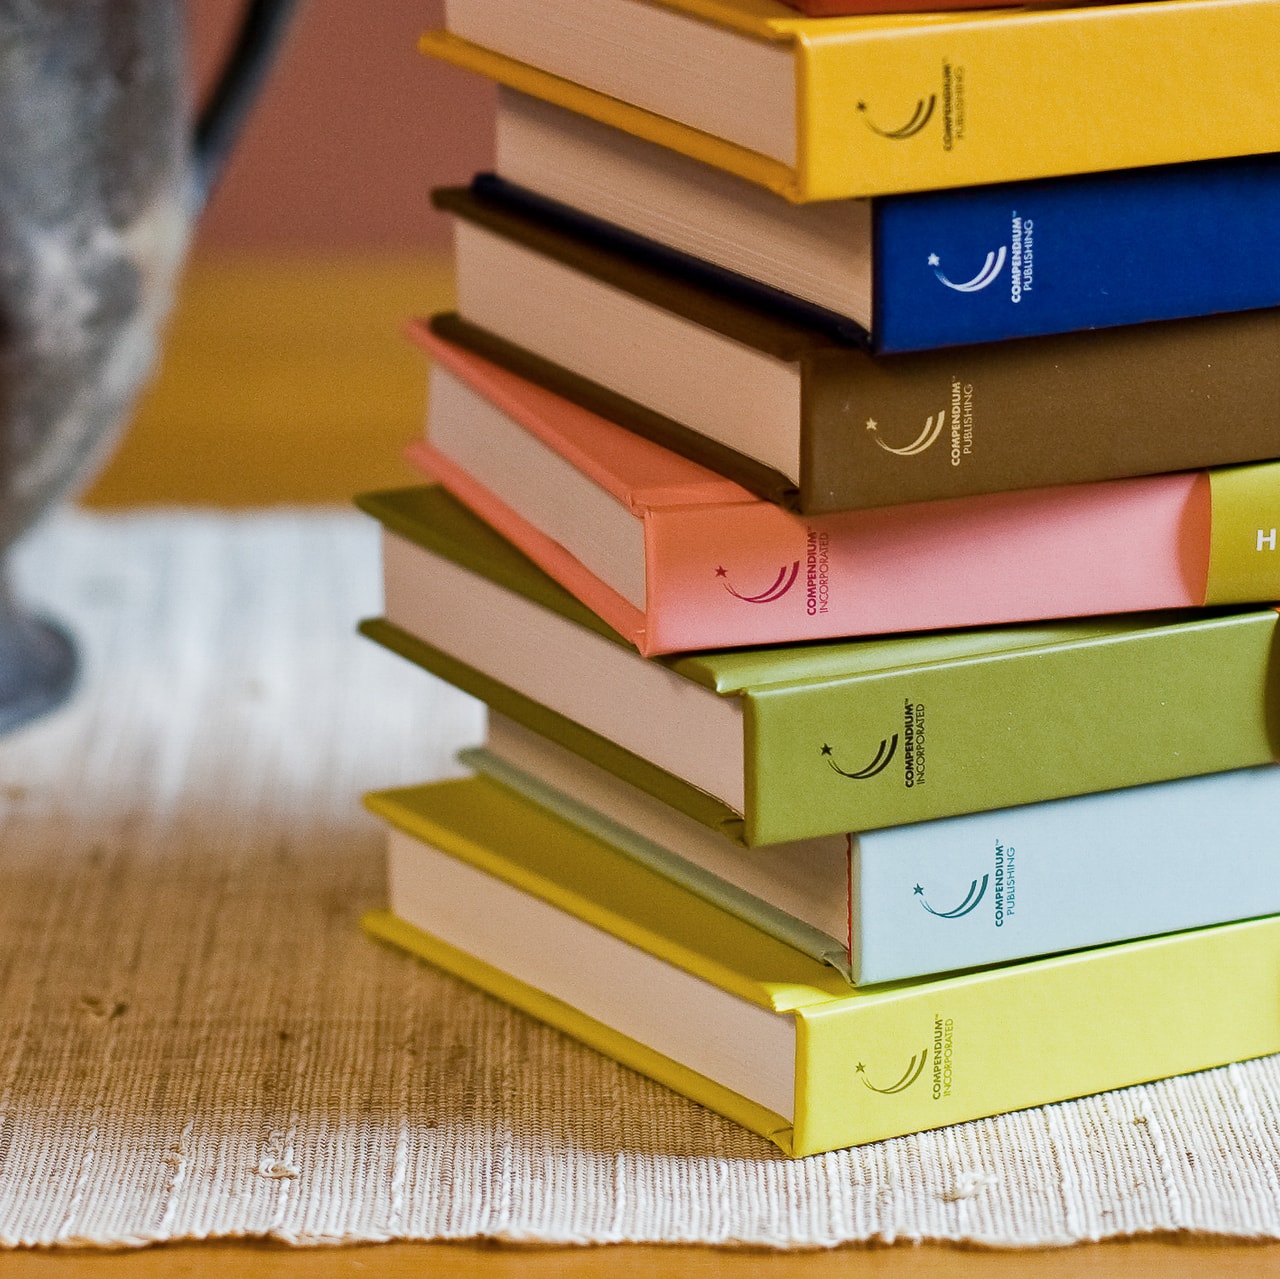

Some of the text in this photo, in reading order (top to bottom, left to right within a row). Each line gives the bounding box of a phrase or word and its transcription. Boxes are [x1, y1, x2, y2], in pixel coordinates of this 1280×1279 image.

[1023, 219, 1034, 292] PUBLISHING
[963, 383, 974, 455] PUBLISHING
[819, 532, 830, 614] INCORPORATED
[916, 703, 926, 785] INCORPORATED
[1006, 847, 1016, 916] PUBLISHING
[943, 1018, 955, 1097] INCORPORATED
